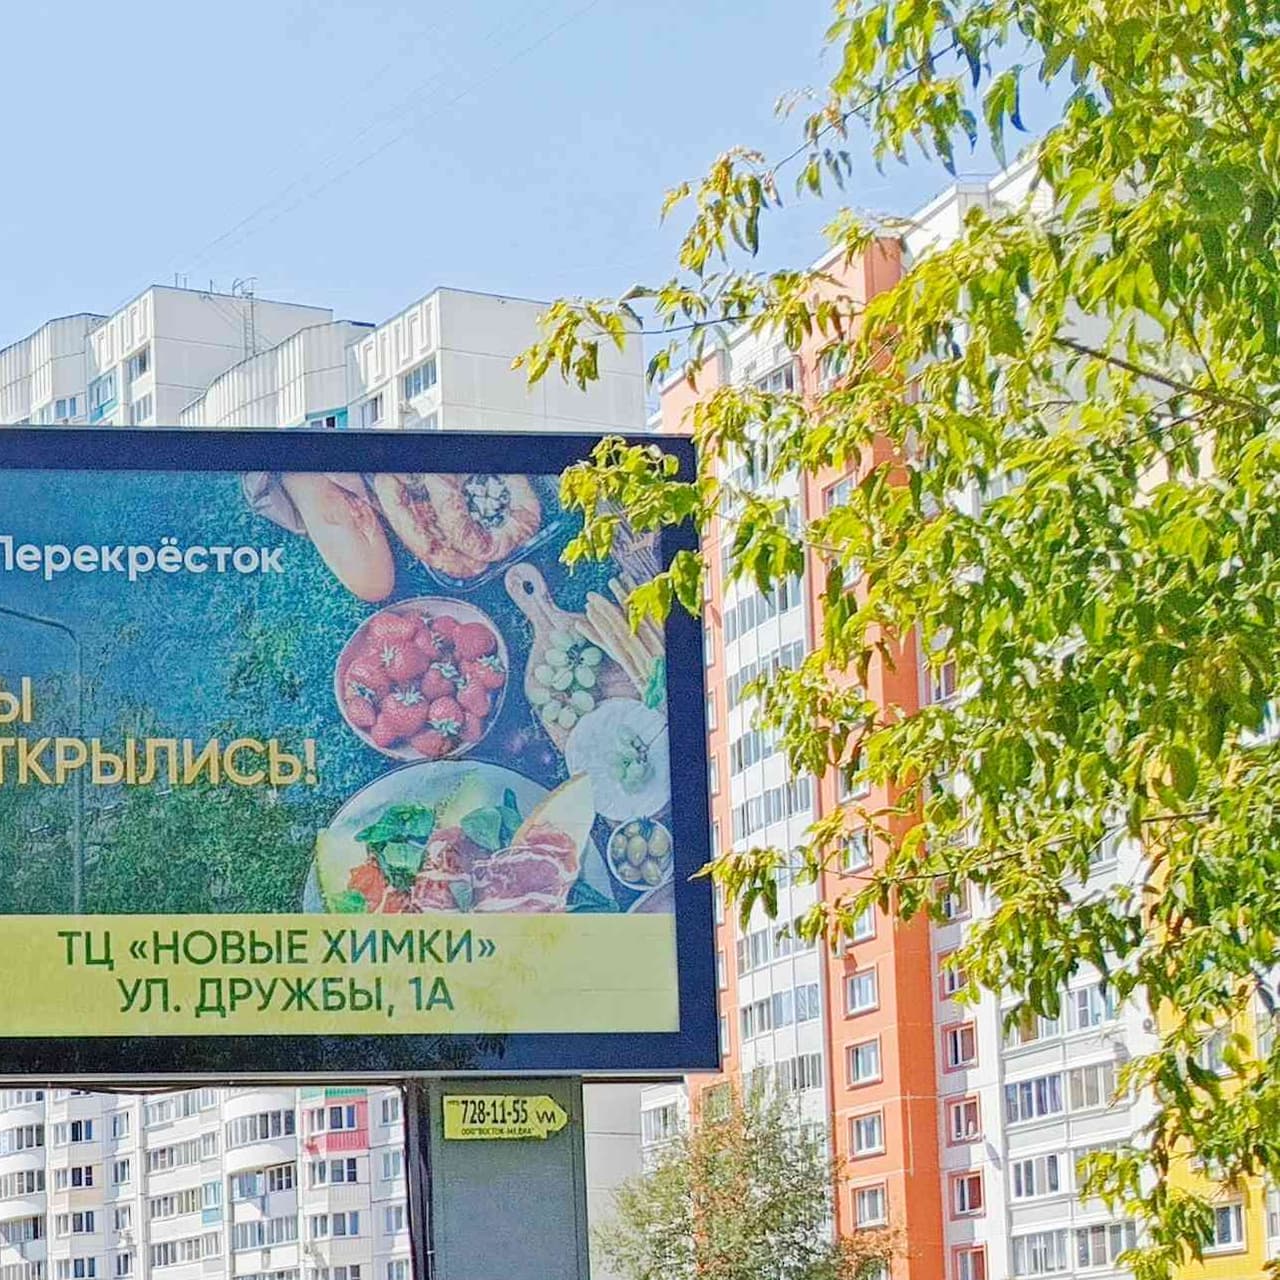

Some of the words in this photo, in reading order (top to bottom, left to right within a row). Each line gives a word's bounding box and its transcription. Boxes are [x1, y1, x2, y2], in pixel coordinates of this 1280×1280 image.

[57, 930, 114, 971] ТЦ
[128, 929, 308, 965] «НОВЫЕ
[321, 928, 496, 965] ХИМКИ»
[116, 977, 182, 1013] УЛ.
[194, 976, 395, 1018] ДРУЖБЫ,
[408, 975, 454, 1012] 1А
[461, 1100, 528, 1124] 728-11-55
